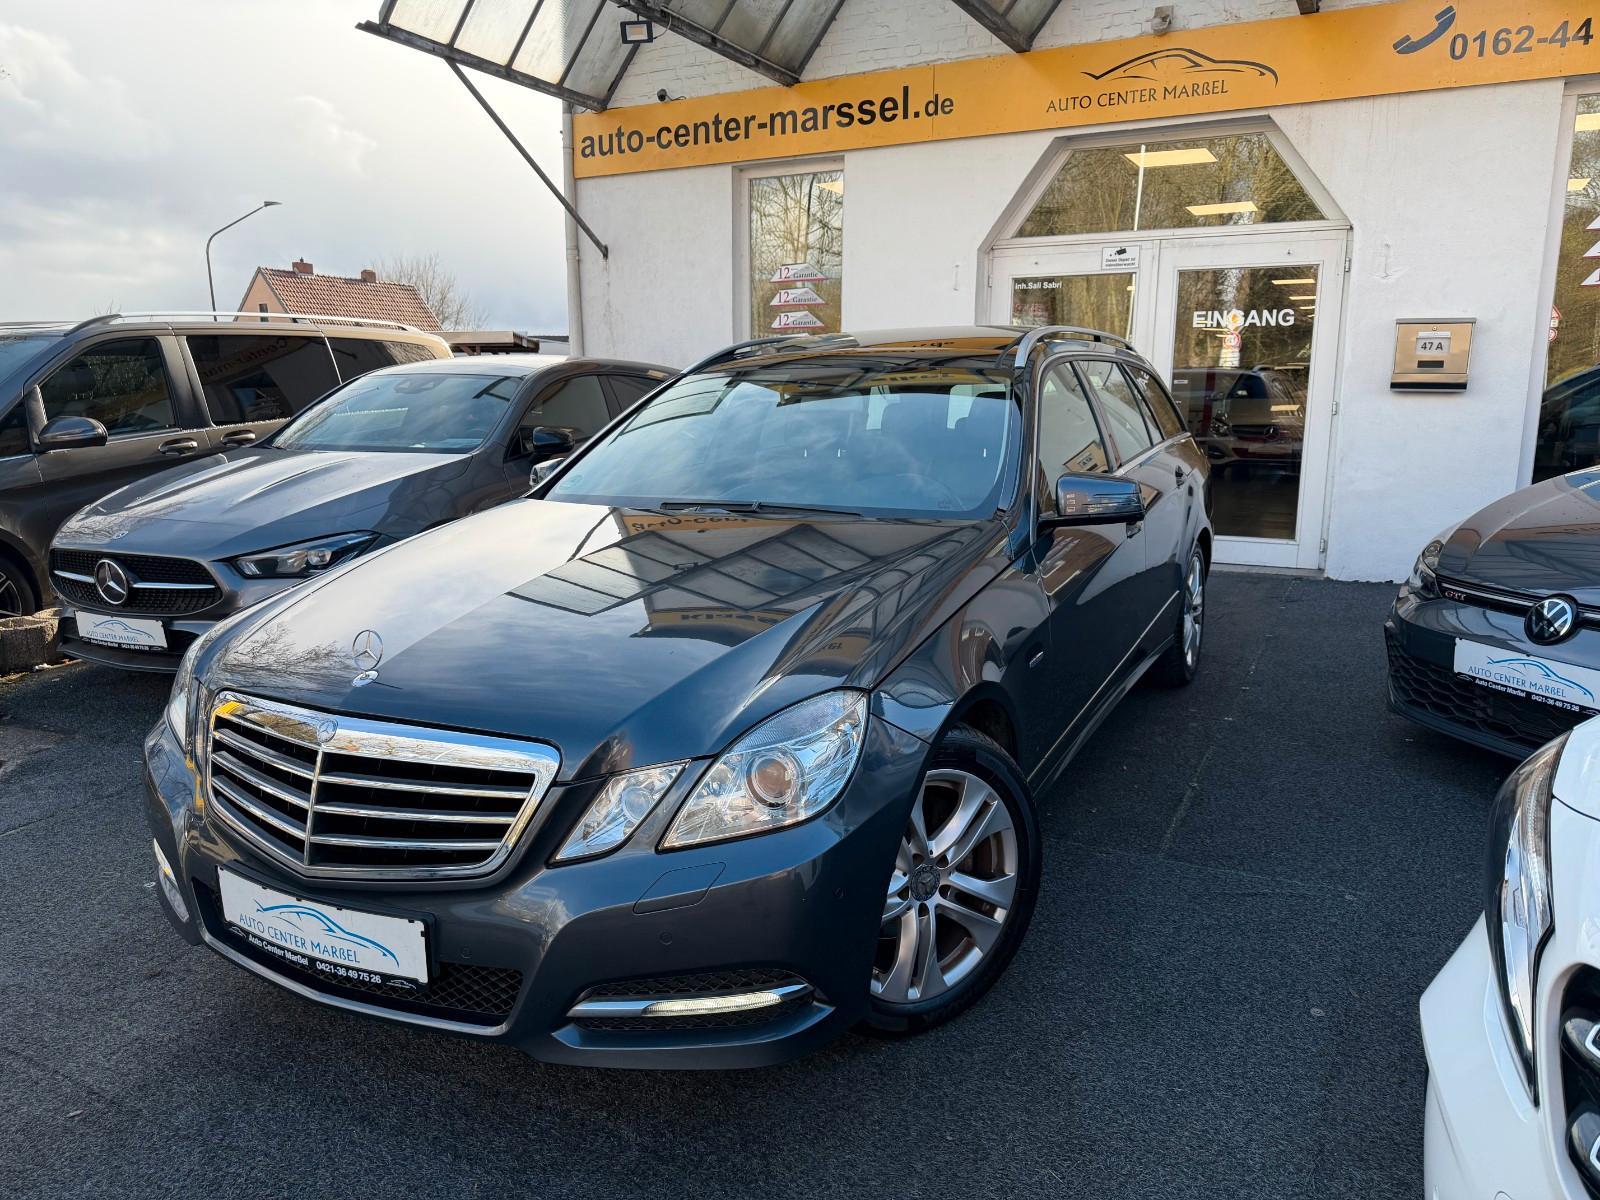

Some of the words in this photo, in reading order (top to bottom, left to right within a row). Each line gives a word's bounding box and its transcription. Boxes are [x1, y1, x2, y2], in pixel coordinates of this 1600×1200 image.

[1450, 17, 1594, 60] 0162-44
[1046, 95, 1092, 113] AUTO
[1097, 88, 1158, 108] CENTER
[1163, 79, 1229, 100] MARßEL
[580, 85, 954, 159] auto-center-marssel.de
[779, 267, 790, 279] 12
[778, 291, 790, 303] 12
[778, 314, 790, 326] 12
[1192, 308, 1295, 328] EINGANG
[1420, 341, 1434, 350] 47
[1435, 342, 1443, 350] A
[1445, 590, 1467, 601] GTI
[1468, 665, 1492, 679] AUTO
[1493, 672, 1526, 688] CENTER
[1475, 678, 1488, 686] Auto
[1488, 682, 1506, 692] Center
[1562, 702, 1571, 710] 75
[239, 912, 265, 934] AUTO
[267, 924, 308, 950] CENTER
[248, 933, 262, 947] Auto
[262, 941, 284, 956] Center
[316, 961, 347, 977] 0421-36
[347, 969, 358, 979] 49
[358, 971, 370, 982] 75
